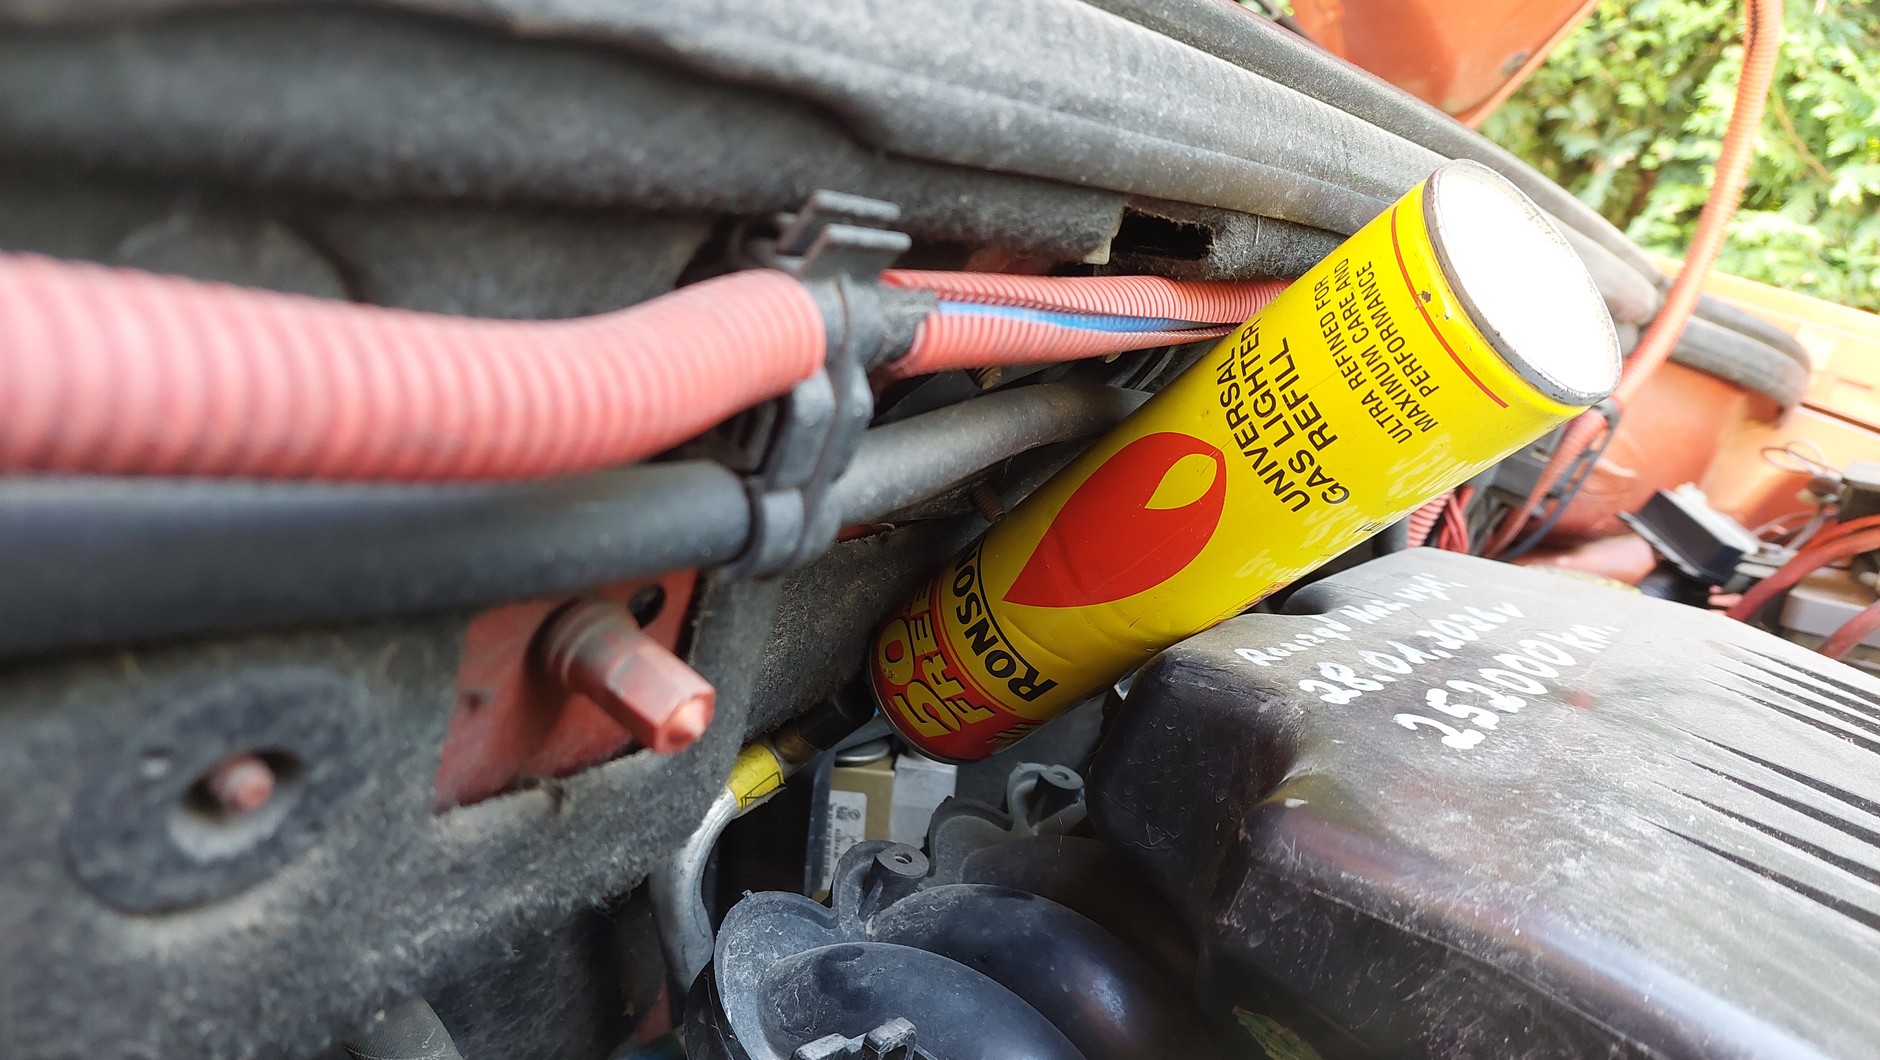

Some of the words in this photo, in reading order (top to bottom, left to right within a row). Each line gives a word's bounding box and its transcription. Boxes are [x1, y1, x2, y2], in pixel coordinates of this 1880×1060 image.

[1314, 275, 1332, 311] FOR
[1334, 258, 1351, 292] AND
[1320, 311, 1367, 391] REFINED
[1338, 291, 1369, 344] CARE
[1356, 260, 1440, 398] PERFORMANCE
[1239, 317, 1296, 448] LIGHTER
[1268, 336, 1339, 452] REFILL
[1360, 344, 1439, 433] MAXIMUM
[1360, 389, 1413, 444] ULTRA
[1216, 346, 1311, 513] UNIVERSAL
[1287, 449, 1350, 505] GAS
[1392, 639, 1577, 750] 252000
